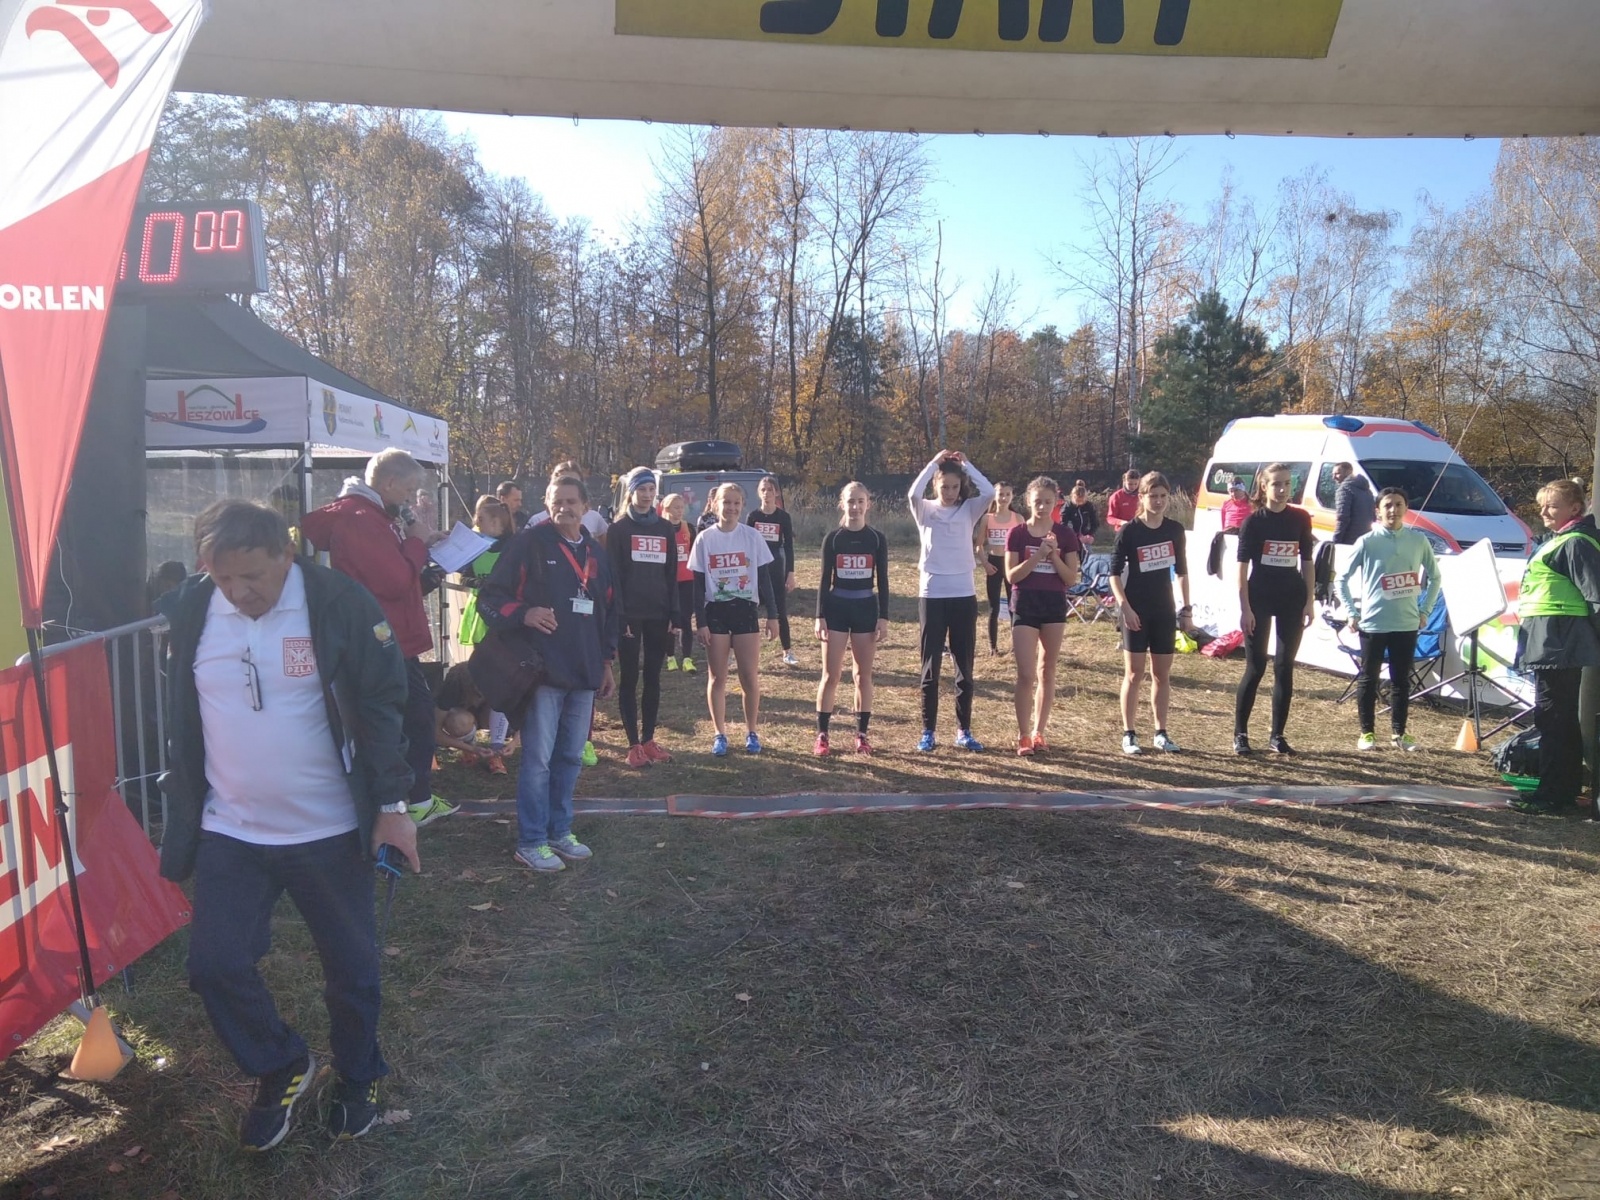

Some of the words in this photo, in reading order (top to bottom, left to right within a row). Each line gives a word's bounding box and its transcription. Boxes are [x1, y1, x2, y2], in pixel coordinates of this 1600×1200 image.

[193, 210, 242, 250] 00
[0, 283, 104, 310] ORLEN
[757, 524, 777, 534] 332
[989, 529, 1007, 538] 330
[637, 538, 661, 552] 315
[1268, 543, 1295, 556] 322
[1142, 545, 1170, 561] 308
[715, 554, 740, 568] 314
[842, 556, 867, 568] 310
[1148, 559, 1168, 567] STARTER
[1384, 574, 1416, 589] 304
[1391, 589, 1414, 597] STARTER
[287, 665, 312, 674] PZLA
